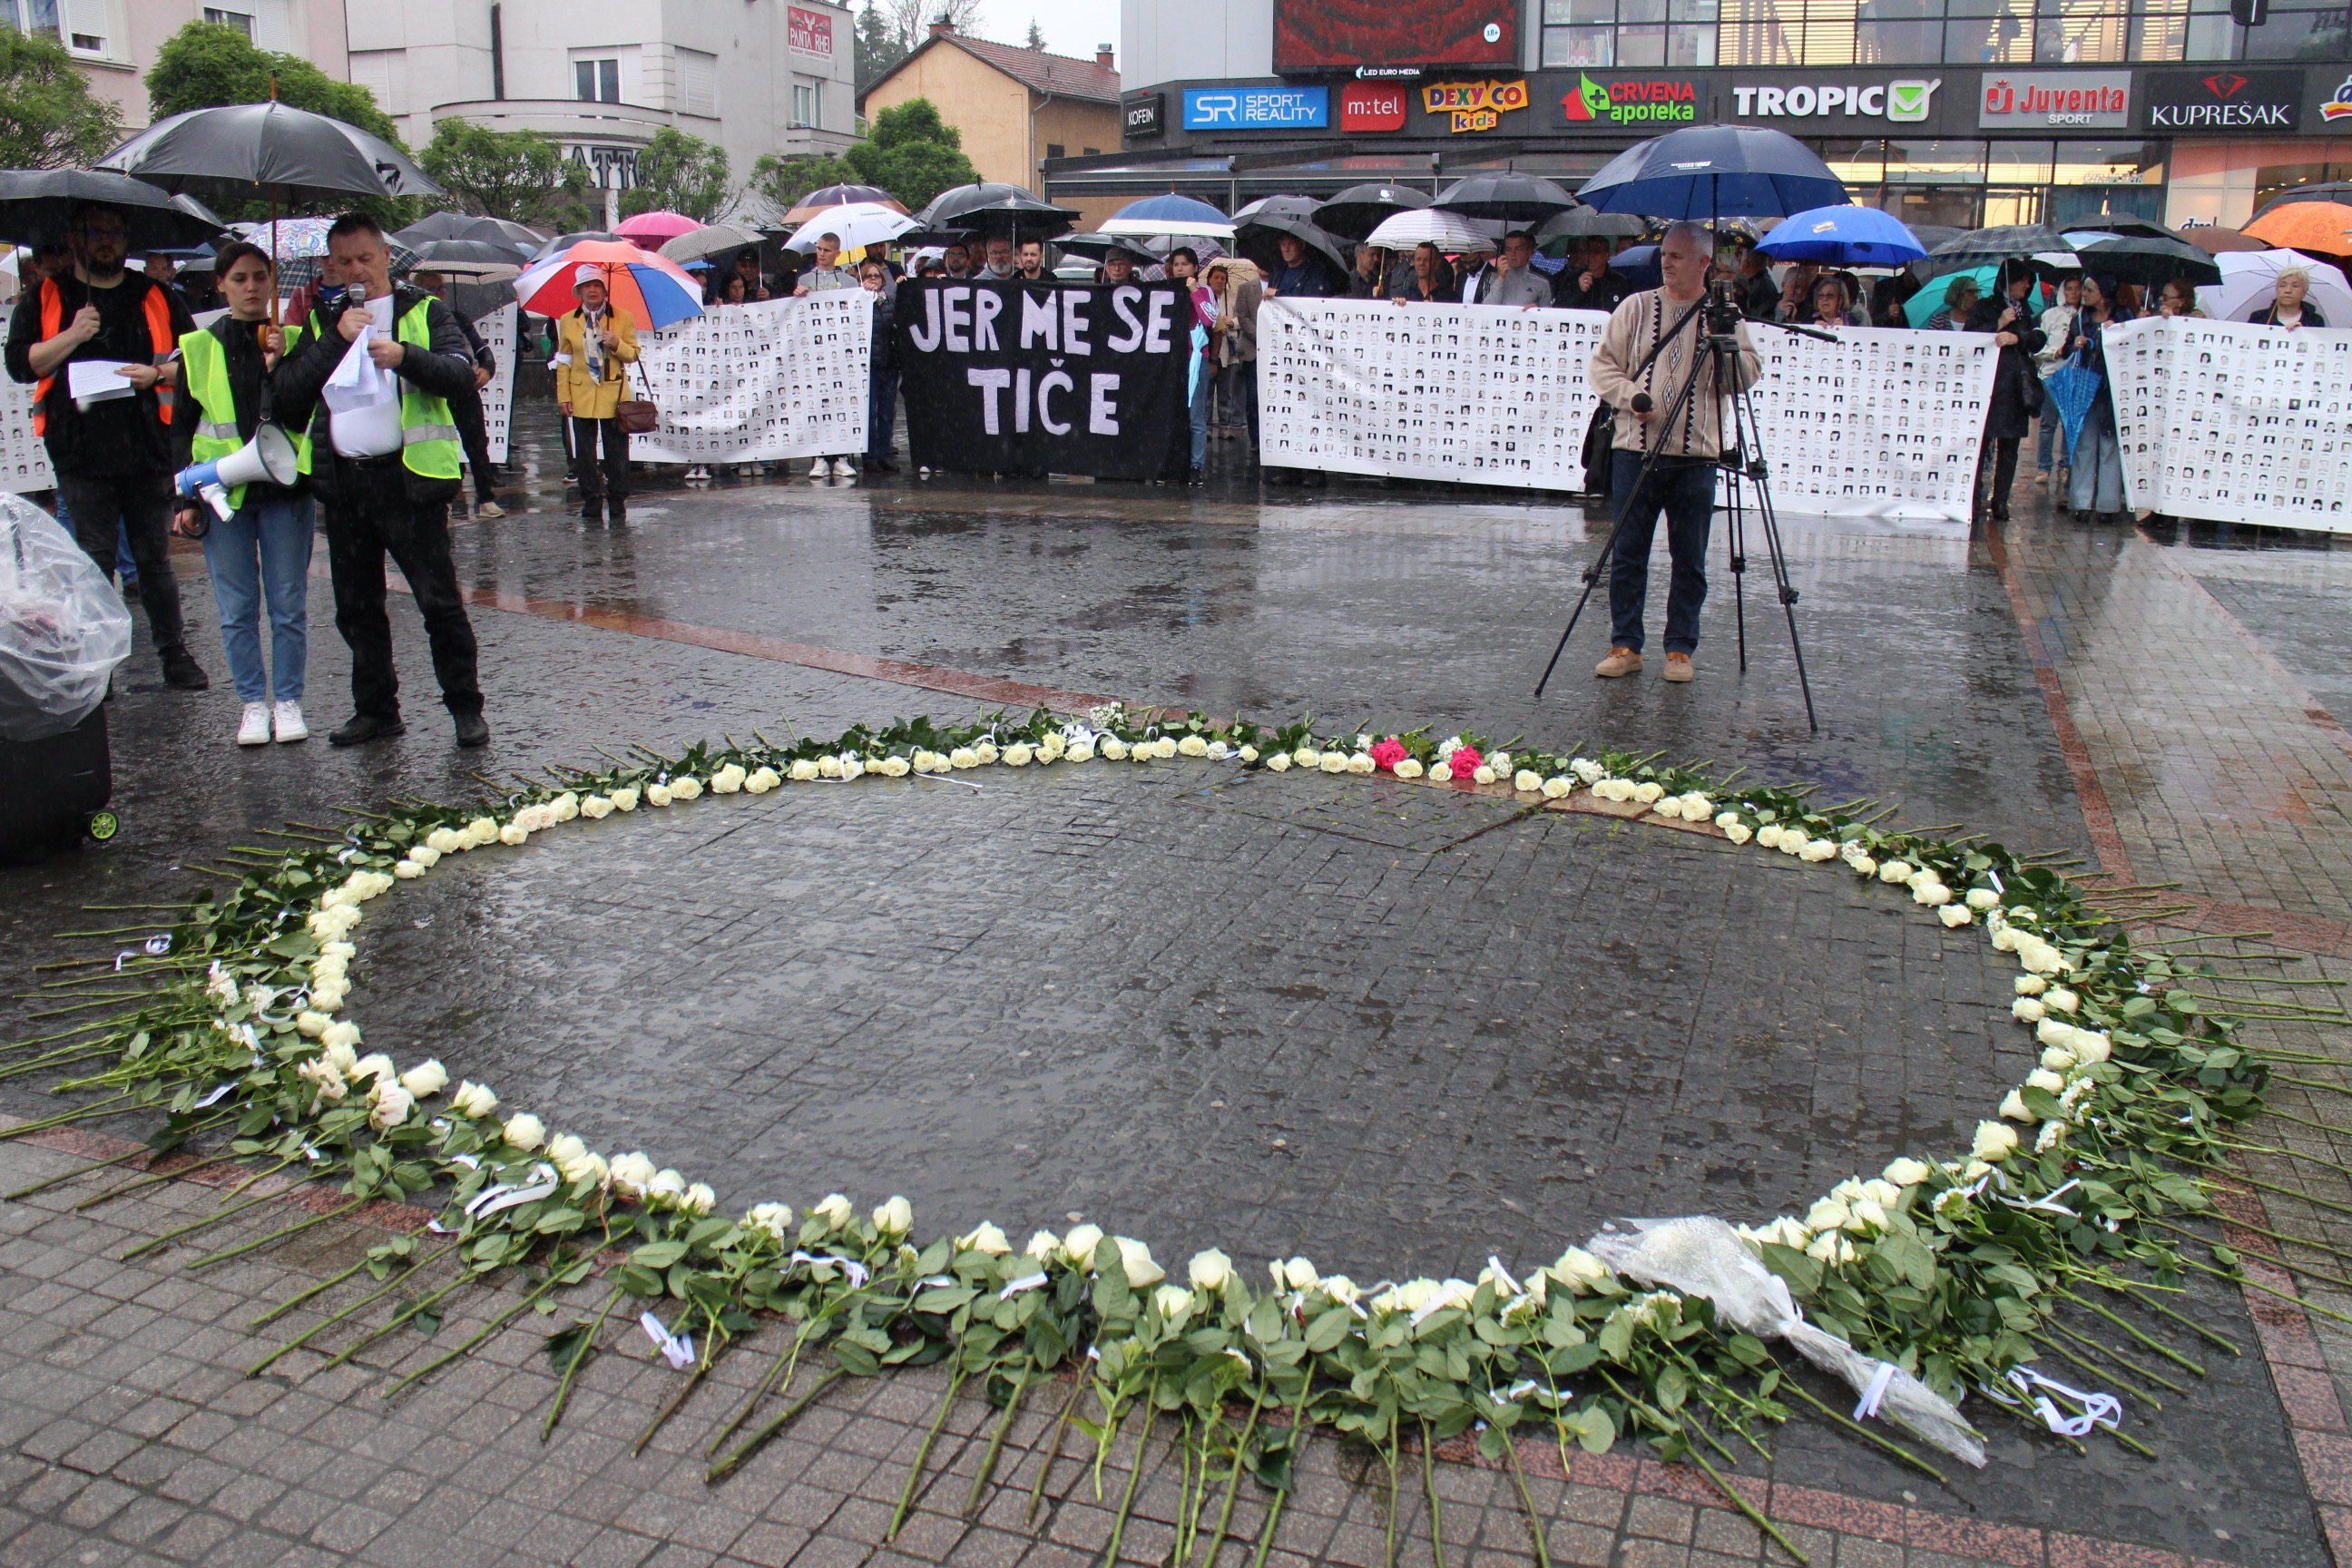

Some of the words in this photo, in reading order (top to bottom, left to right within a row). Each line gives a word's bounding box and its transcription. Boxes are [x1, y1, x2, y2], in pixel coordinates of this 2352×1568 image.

[789, 27, 812, 50] PANTA
[815, 34, 830, 54] RHEI
[1246, 93, 1304, 108] SPORT
[1429, 87, 1485, 107] DEXY
[1491, 86, 1522, 105] CO
[1609, 82, 1696, 102] CRVENA
[1733, 85, 1885, 116] TROPIC
[2020, 84, 2126, 112] Juventa
[1128, 107, 1154, 126] KOFEIN
[1192, 96, 1237, 122] SR
[1246, 107, 1317, 122] REALITY
[1348, 97, 1398, 114] m:tel
[1610, 100, 1694, 125] apoteka
[2151, 101, 2290, 125] KUPREŠAK
[1455, 113, 1495, 130] kids
[2047, 114, 2093, 124] SPORT
[908, 287, 1004, 353] JER
[1020, 289, 1092, 356] ME
[1107, 285, 1175, 354] SE
[967, 358, 1121, 436] TIČE
